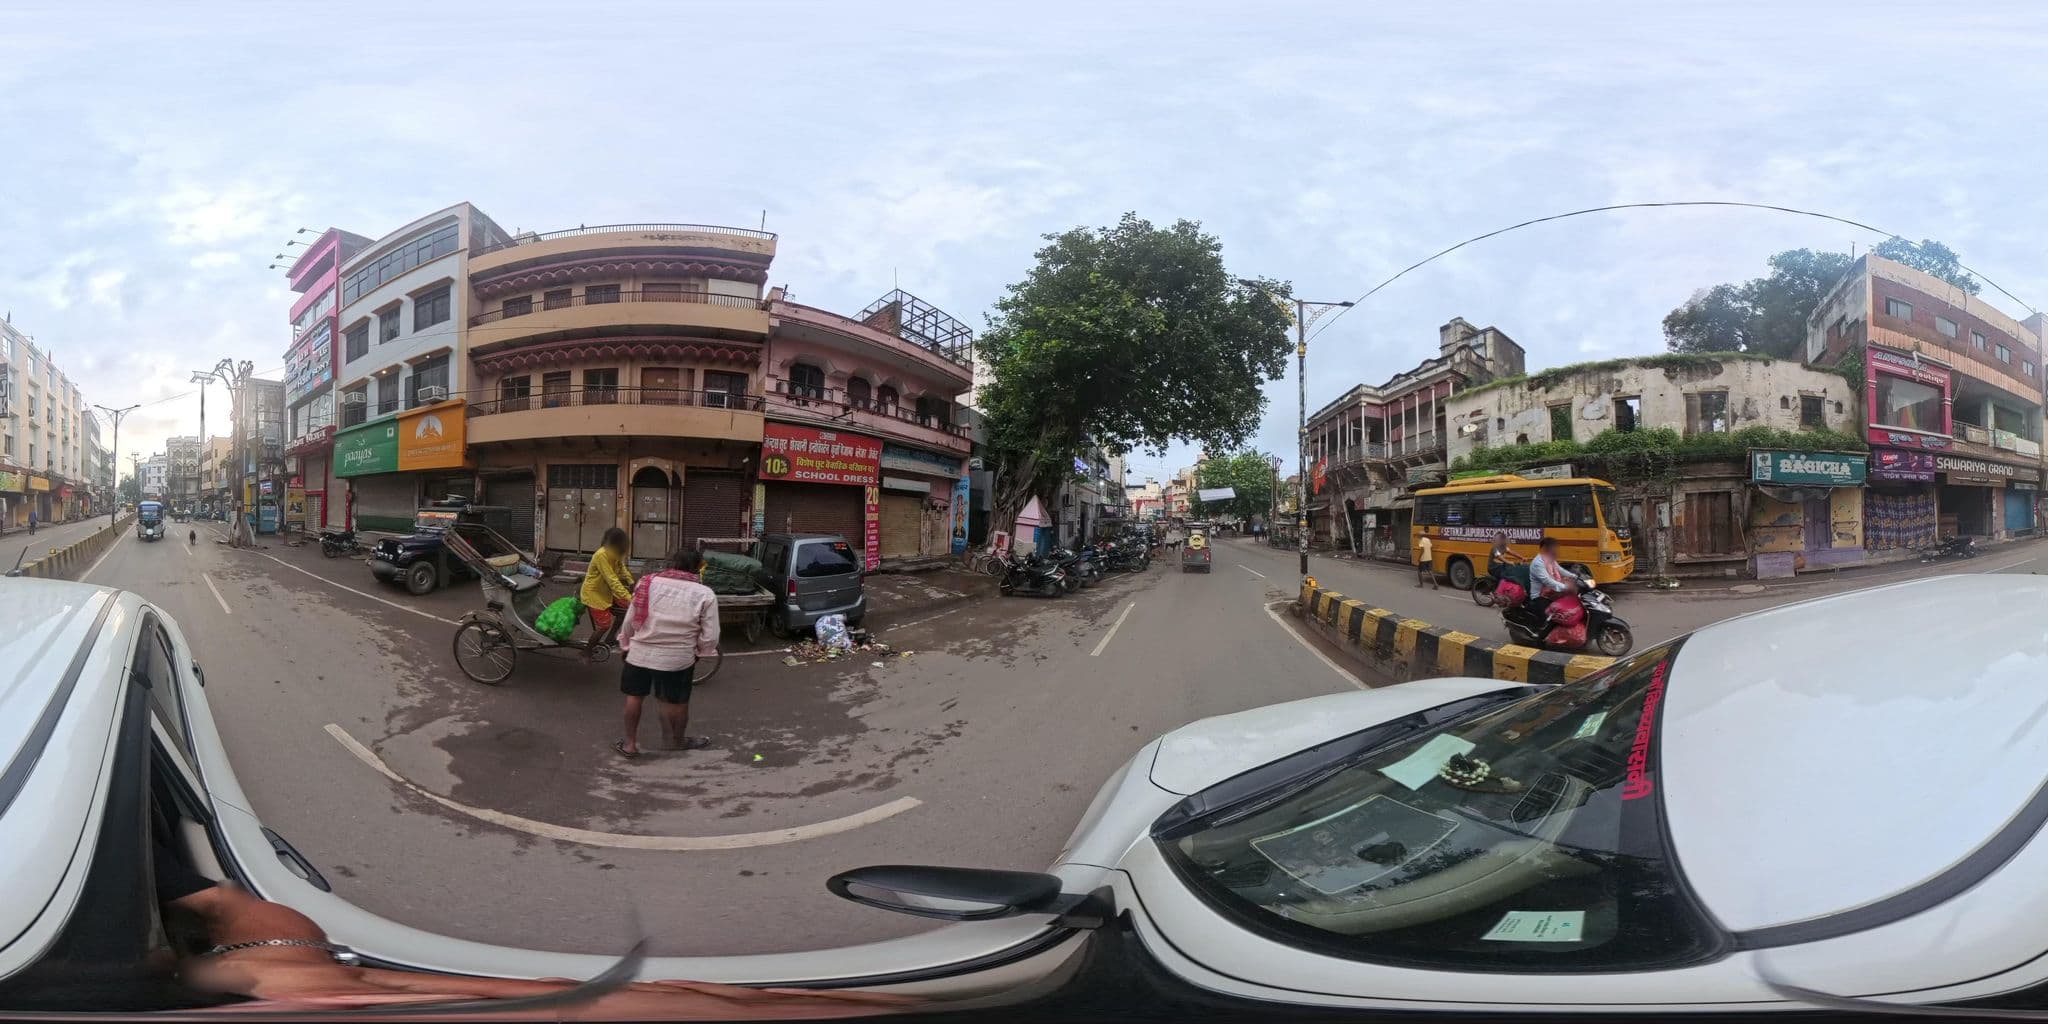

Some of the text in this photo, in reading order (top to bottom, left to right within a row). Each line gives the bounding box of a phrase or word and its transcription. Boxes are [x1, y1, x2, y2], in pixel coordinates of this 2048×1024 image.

[1779, 458, 1852, 476] BAGICHA
[1936, 457, 1986, 473] SAWARIYA
[1988, 463, 2014, 476] GRAND
[795, 470, 874, 484] SCHOOL DRESS
[1512, 527, 1541, 540] BANARAS
